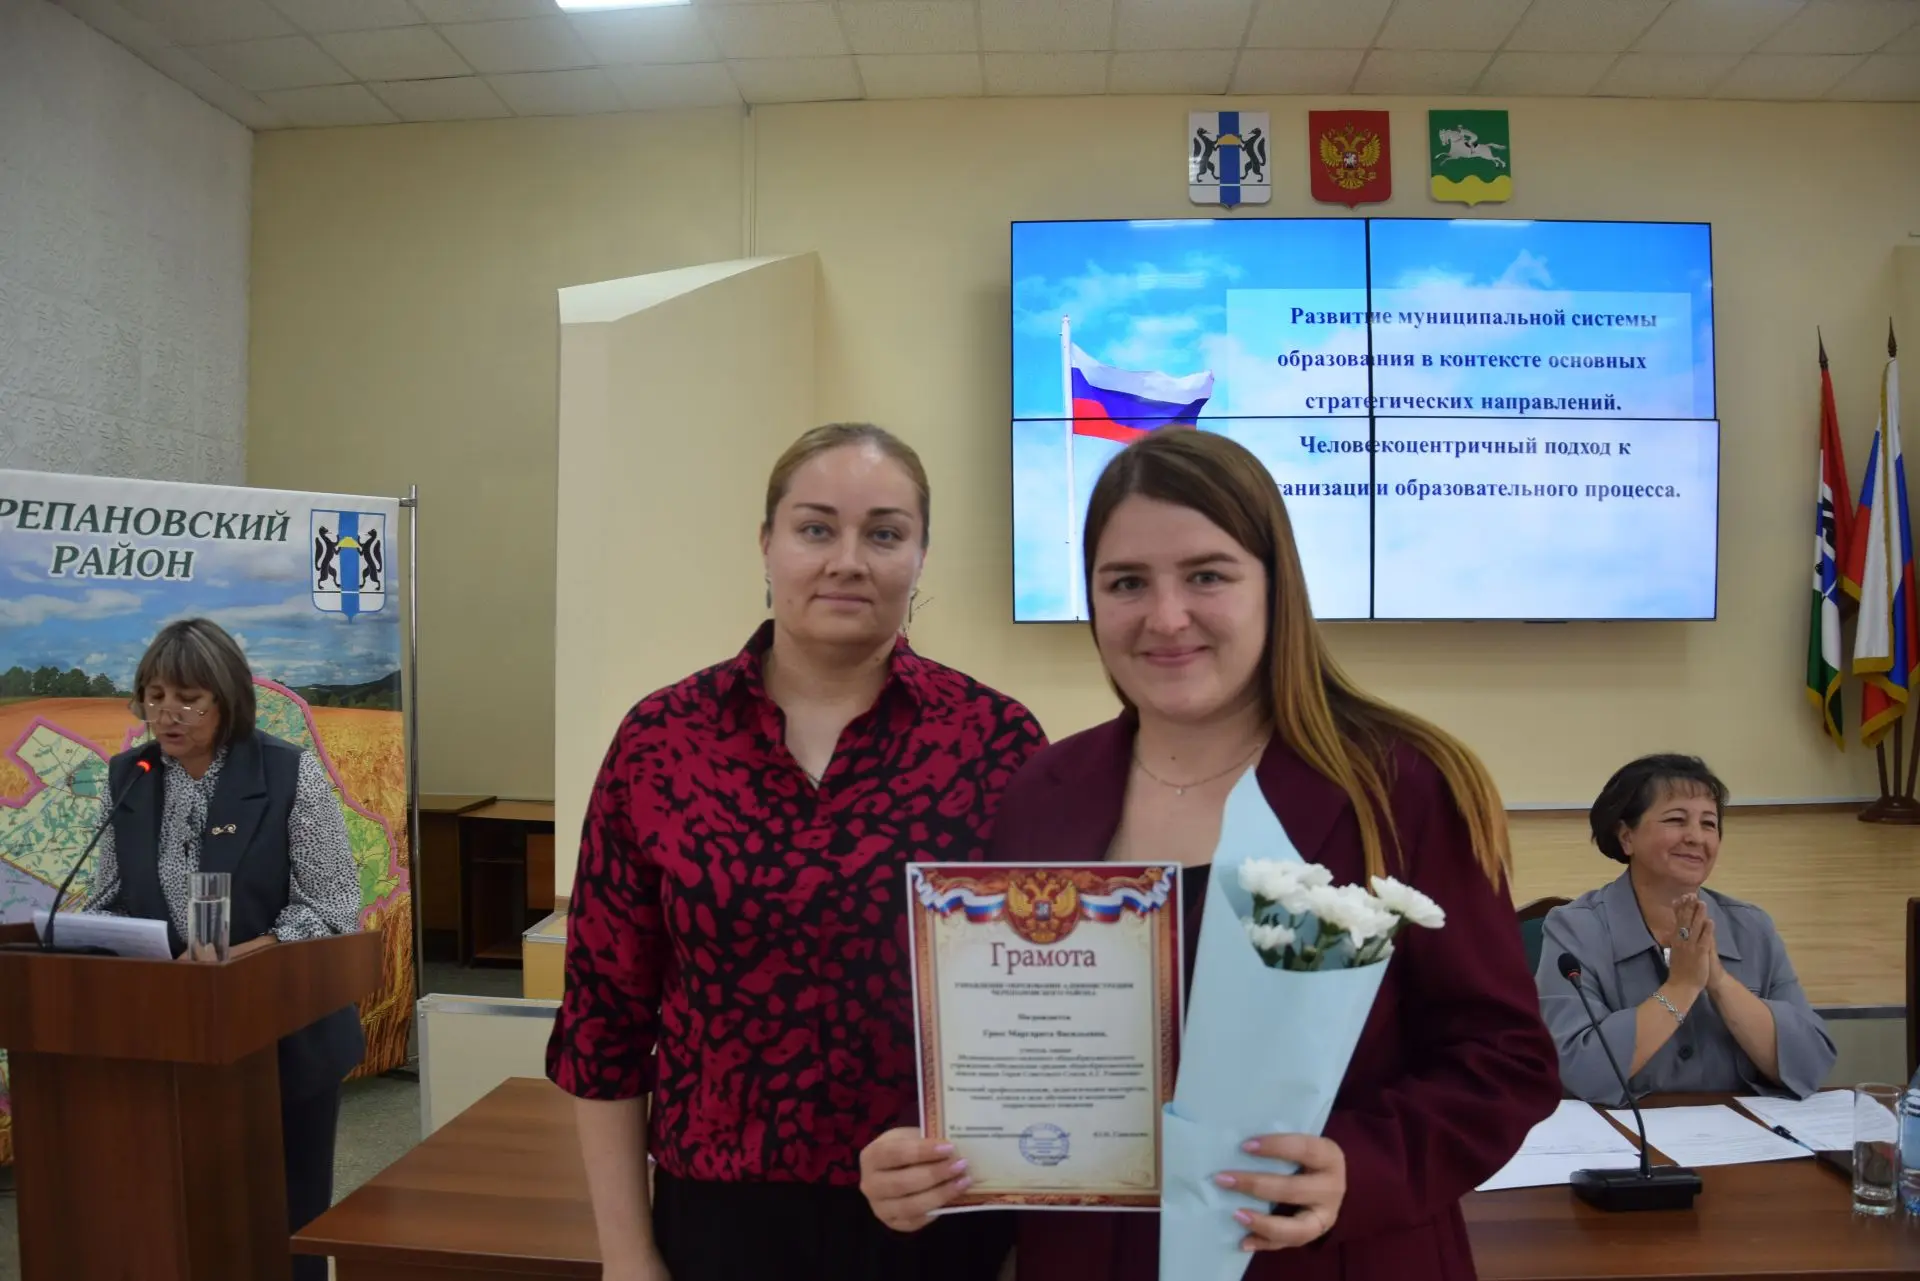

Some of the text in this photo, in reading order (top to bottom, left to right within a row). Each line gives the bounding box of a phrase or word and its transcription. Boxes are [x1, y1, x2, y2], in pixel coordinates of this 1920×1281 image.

[1291, 307, 1657, 328] Развитие муниципальной системы
[1277, 350, 1647, 371] образования в контексте основных
[1305, 394, 1622, 414] стратегических направлений.
[1299, 436, 1631, 458] Человекоцентричный подход к
[1395, 479, 1578, 500] образовательного
[1585, 484, 1681, 502] процесса.
[51, 541, 194, 578] РАЙОН
[991, 942, 1096, 974] Грамота
